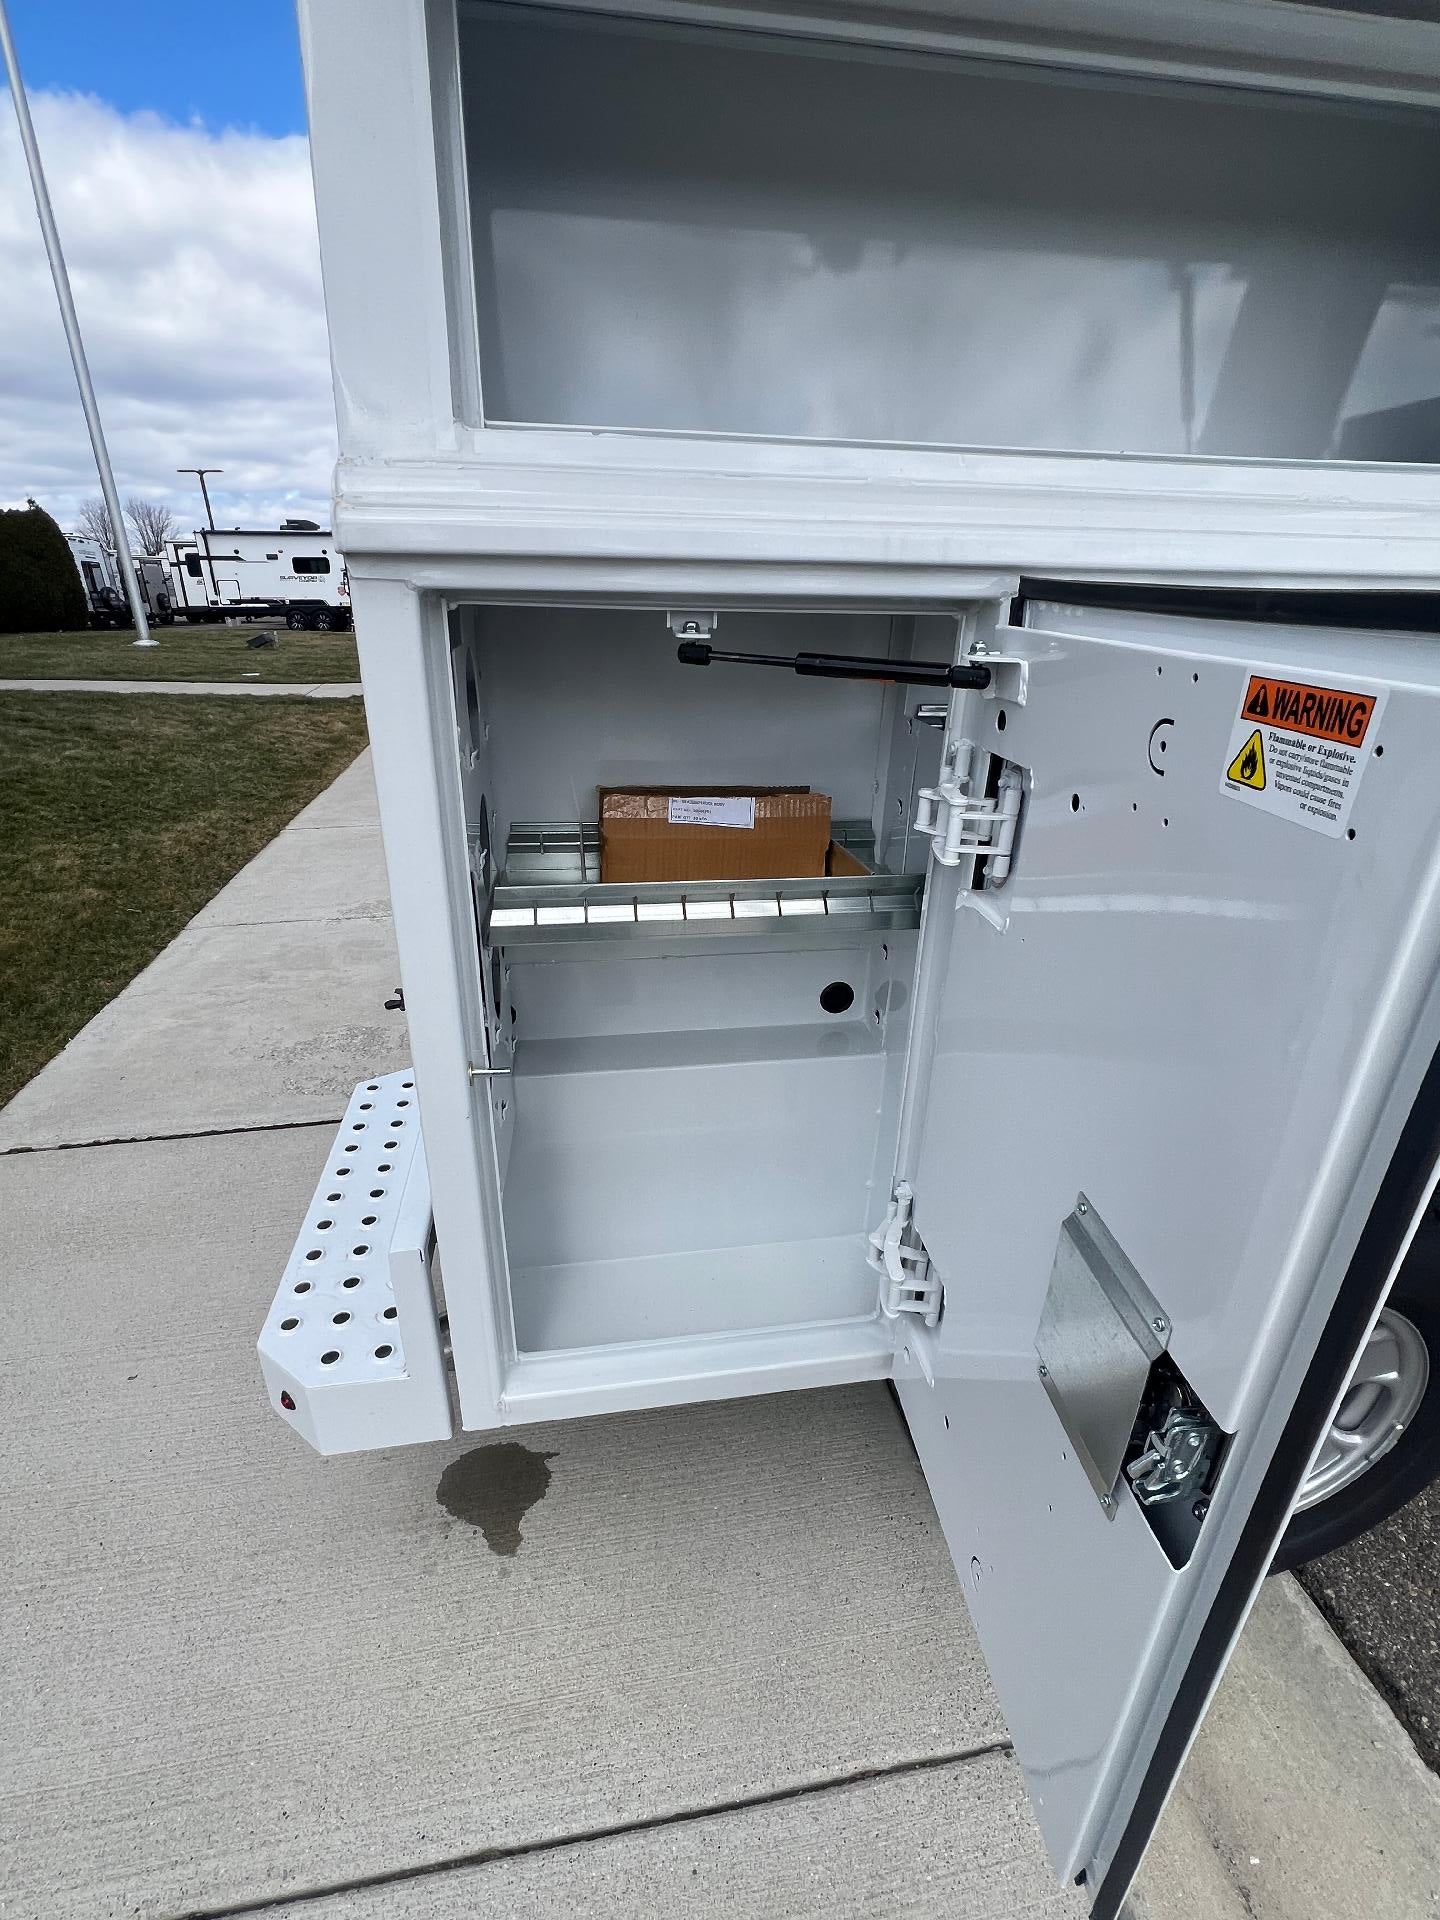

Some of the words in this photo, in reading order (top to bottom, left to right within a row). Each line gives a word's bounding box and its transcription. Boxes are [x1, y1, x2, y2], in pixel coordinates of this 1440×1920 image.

[1271, 686, 1367, 739] WARNING
[1268, 731, 1307, 750] Flammable
[1307, 744, 1317, 753] or
[1317, 744, 1357, 764] Explosive.
[1268, 744, 1278, 754] Do
[1278, 748, 1288, 757] not
[1319, 758, 1354, 776] flammable
[1275, 758, 1302, 773] explosive
[1341, 778, 1349, 788] in
[1274, 780, 1292, 794] Vapors
[1292, 787, 1309, 799] could
[1309, 794, 1327, 805] cause
[1327, 798, 1341, 811] fires
[1299, 801, 1308, 810] or
